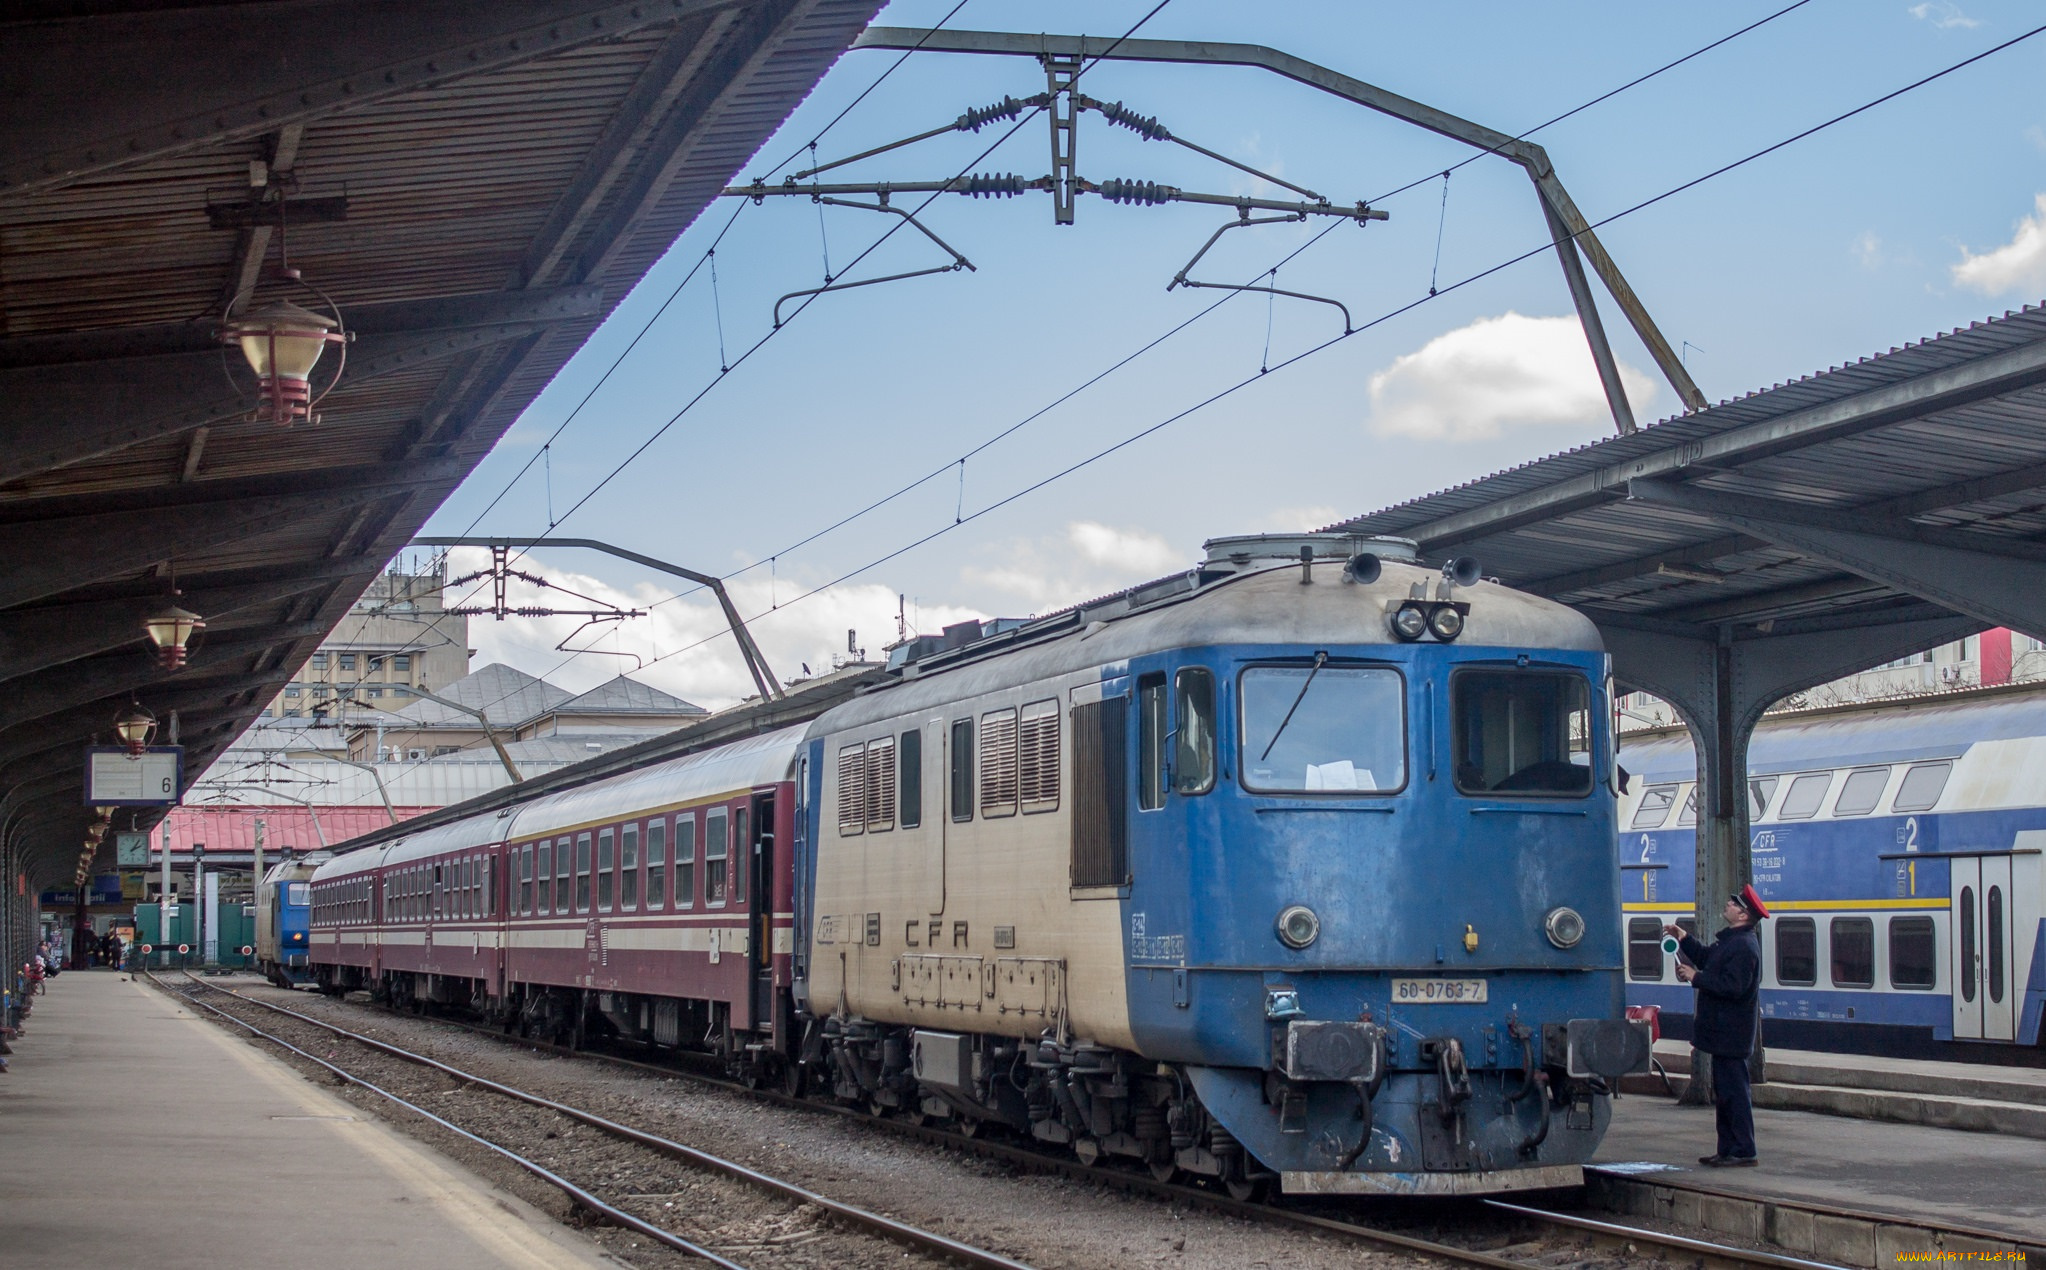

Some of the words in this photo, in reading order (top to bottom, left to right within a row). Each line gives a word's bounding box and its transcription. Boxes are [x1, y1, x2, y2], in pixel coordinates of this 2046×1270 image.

[162, 777, 171, 793] 6
[1760, 834, 1776, 848] CFR
[1905, 816, 1918, 852] 2
[1640, 833, 1650, 863] 2
[1643, 871, 1649, 902] 1
[1908, 861, 1916, 896] 1
[906, 920, 968, 947] CFR
[1400, 982, 1481, 999] 60-0763-7
[1512, 1003, 1518, 1011] 5
